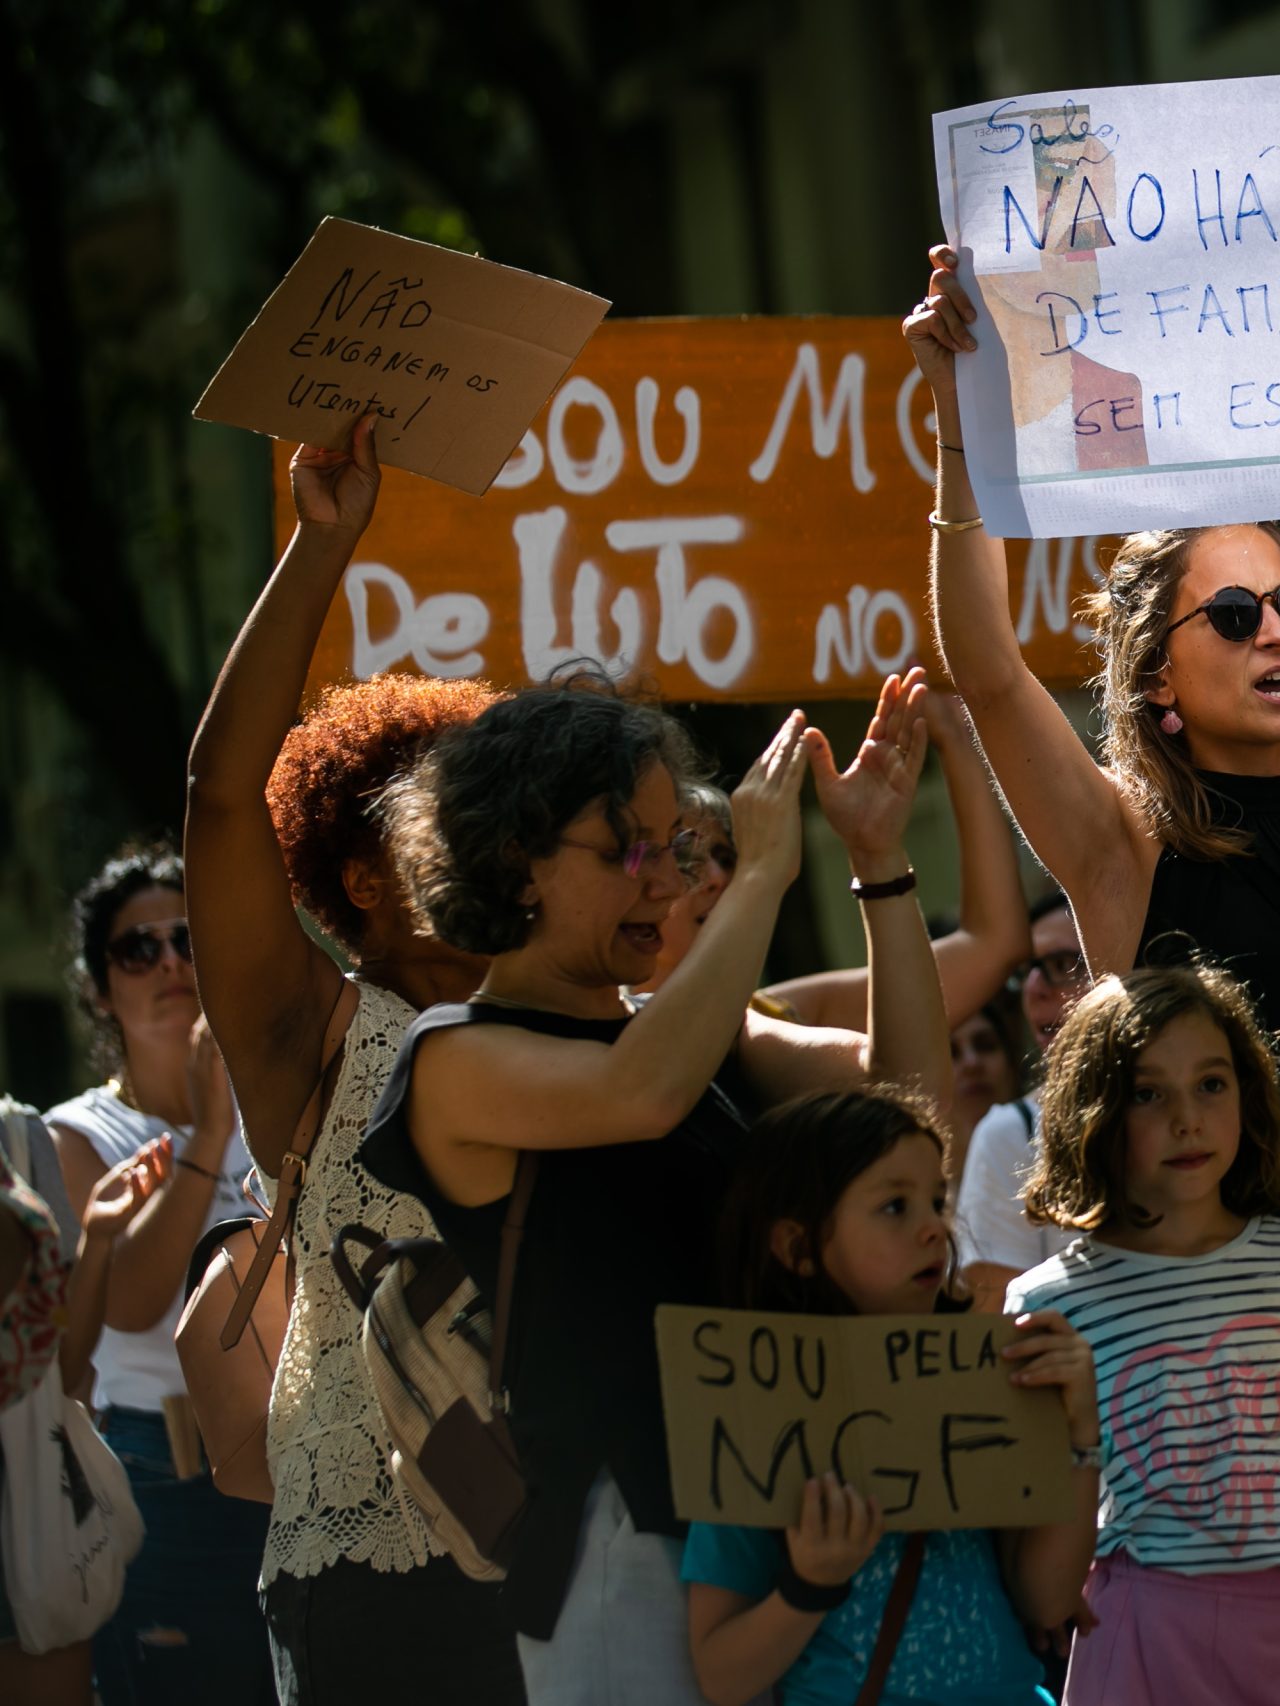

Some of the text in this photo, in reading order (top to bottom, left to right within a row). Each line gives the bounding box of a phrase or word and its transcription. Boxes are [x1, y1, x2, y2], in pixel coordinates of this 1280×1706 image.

[1003, 149, 1165, 254] NÃO
[309, 267, 433, 329] NÃO
[1036, 291, 1123, 357] DE
[289, 331, 450, 382] ENGANEM
[1073, 391, 1182, 437] SEM
[344, 561, 491, 681] De
[812, 583, 917, 684] NO
[692, 1320, 998, 1401] SOU PELA
